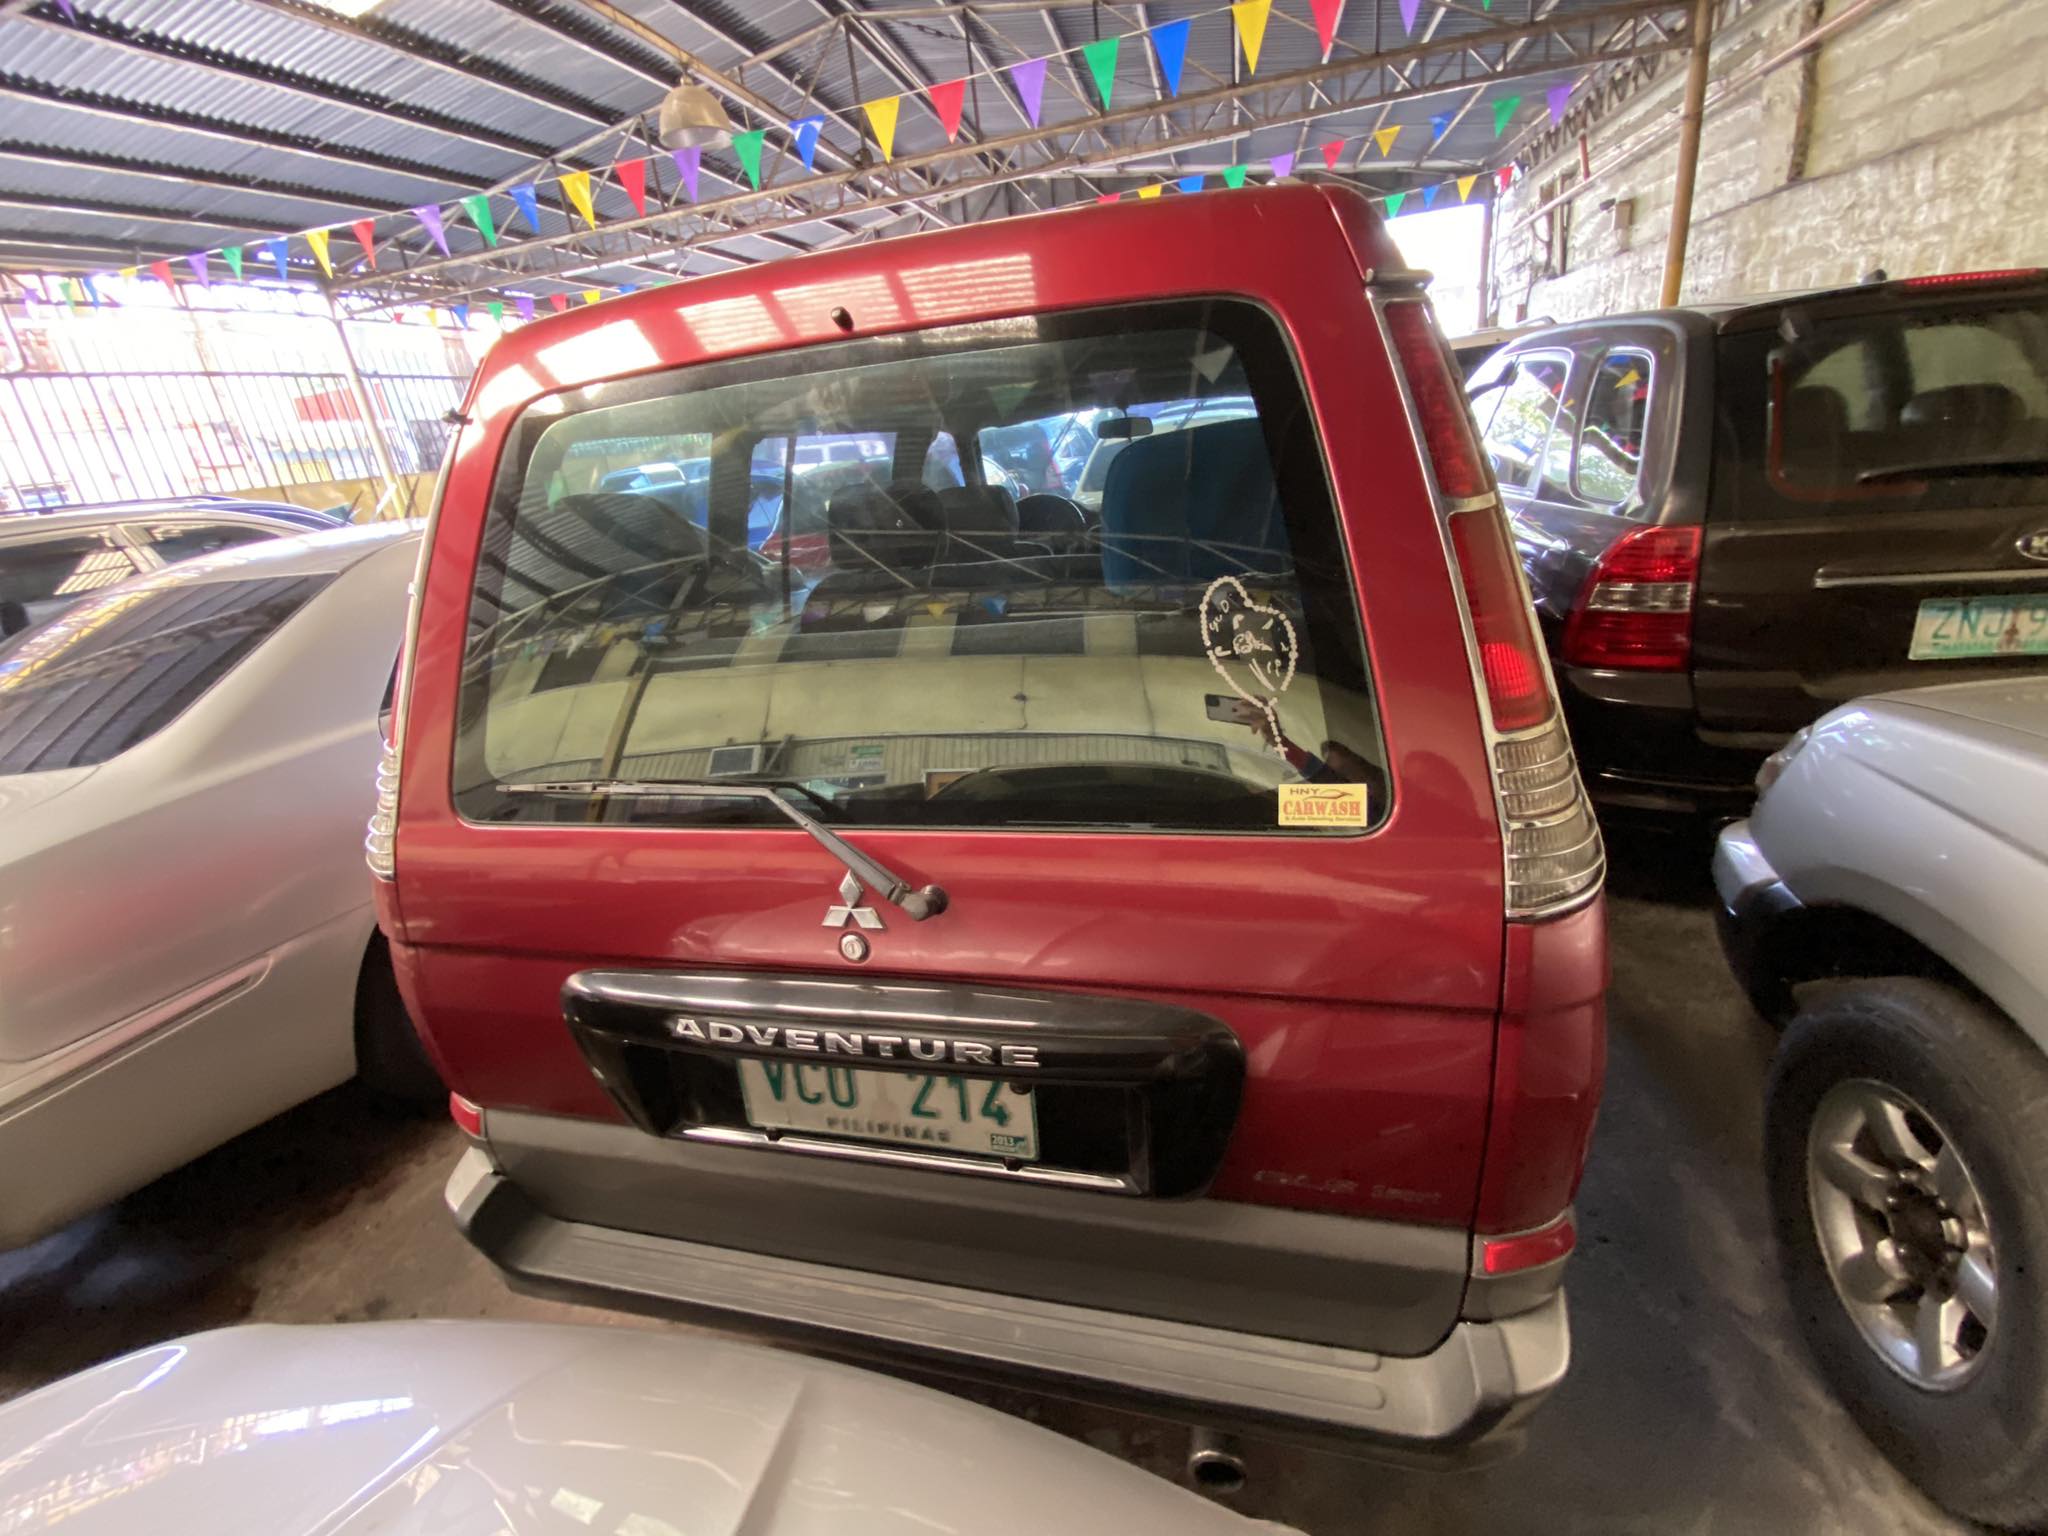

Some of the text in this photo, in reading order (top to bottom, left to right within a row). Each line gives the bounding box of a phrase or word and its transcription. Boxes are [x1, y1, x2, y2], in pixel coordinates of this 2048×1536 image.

[1931, 602, 2008, 640] ZNJ
[1283, 800, 1361, 816] CARWASH
[1290, 787, 1319, 796] HNY
[673, 1018, 1041, 1068] ADVENTURE
[906, 1073, 1011, 1127] 214
